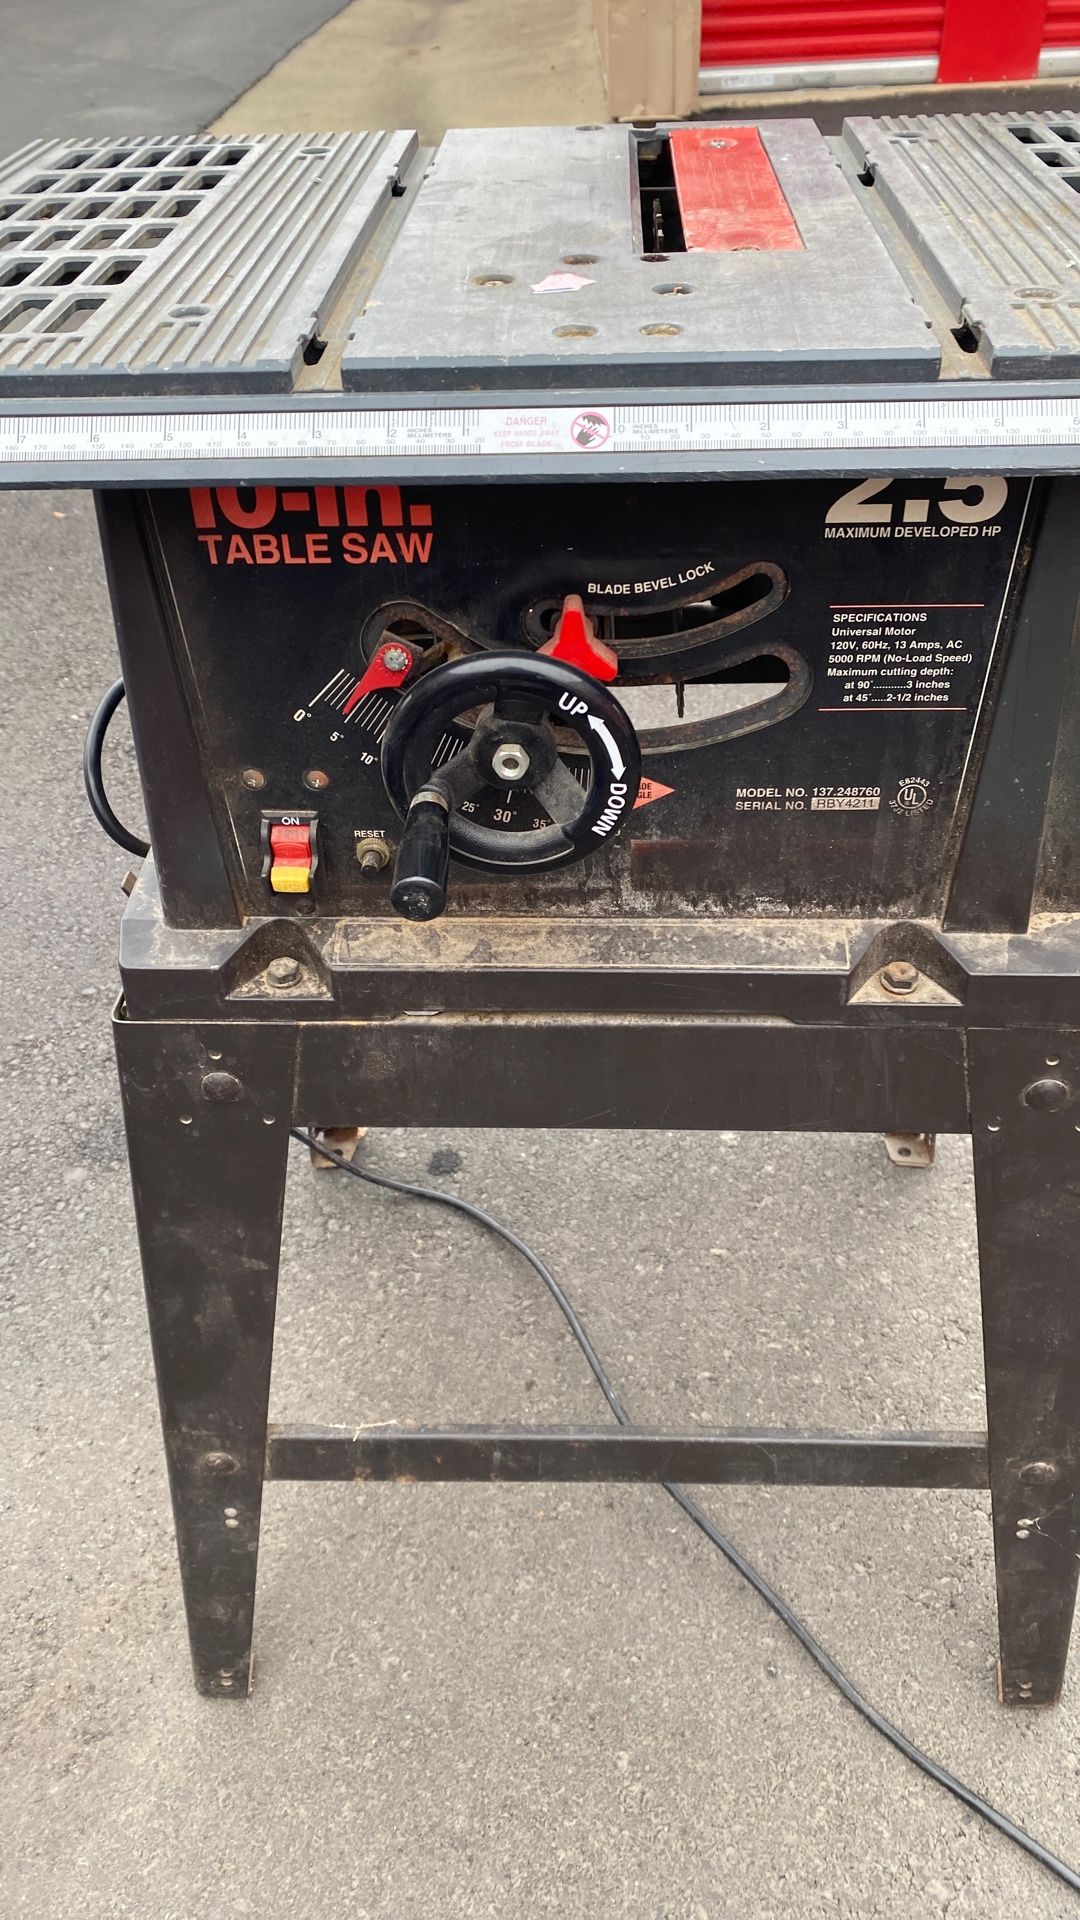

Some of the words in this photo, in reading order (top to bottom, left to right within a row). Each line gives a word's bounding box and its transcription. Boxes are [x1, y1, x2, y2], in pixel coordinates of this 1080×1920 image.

[506, 416, 547, 426] DANGER
[618, 425, 625, 433] 0
[837, 421, 844, 429] 3
[20, 436, 26, 444] 7
[315, 430, 322, 438] 3
[390, 429, 397, 437] 2
[824, 477, 1008, 524] 2.5
[824, 527, 891, 539] MAXIMUM
[894, 526, 978, 538] DEVELOPED
[981, 526, 1002, 537] HP
[198, 534, 332, 565] TABLE
[341, 532, 434, 564] SAW
[587, 583, 631, 595] BLADE
[634, 577, 677, 594] BEVEL
[678, 561, 715, 584] LOCK
[833, 613, 928, 623] SPECIFICATIONS
[831, 627, 882, 636] Universal
[884, 627, 916, 636] Motor
[830, 641, 859, 651] 120V,
[862, 641, 891, 650] 60Hz,
[894, 641, 907, 649] 13
[909, 640, 943, 650] Amps,
[946, 640, 963, 648] AC
[828, 654, 854, 663] 5000
[856, 654, 881, 663] RPM
[883, 654, 932, 664] (No-Load
[935, 653, 973, 664] Speed)
[827, 667, 878, 677] Maximum
[880, 667, 917, 678] cutting
[920, 666, 954, 677] depth:
[915, 680, 951, 689] inches
[842, 694, 853, 702] at
[914, 693, 949, 702] inches
[558, 692, 589, 716] UP
[736, 788, 782, 798] MODEL
[785, 788, 808, 797] NO.
[812, 787, 880, 796] 137.248760
[591, 783, 628, 837] DOWN
[735, 801, 782, 810] SERIAL
[785, 801, 807, 810] NO.
[816, 798, 875, 809] RBY4211
[281, 817, 300, 826] ON
